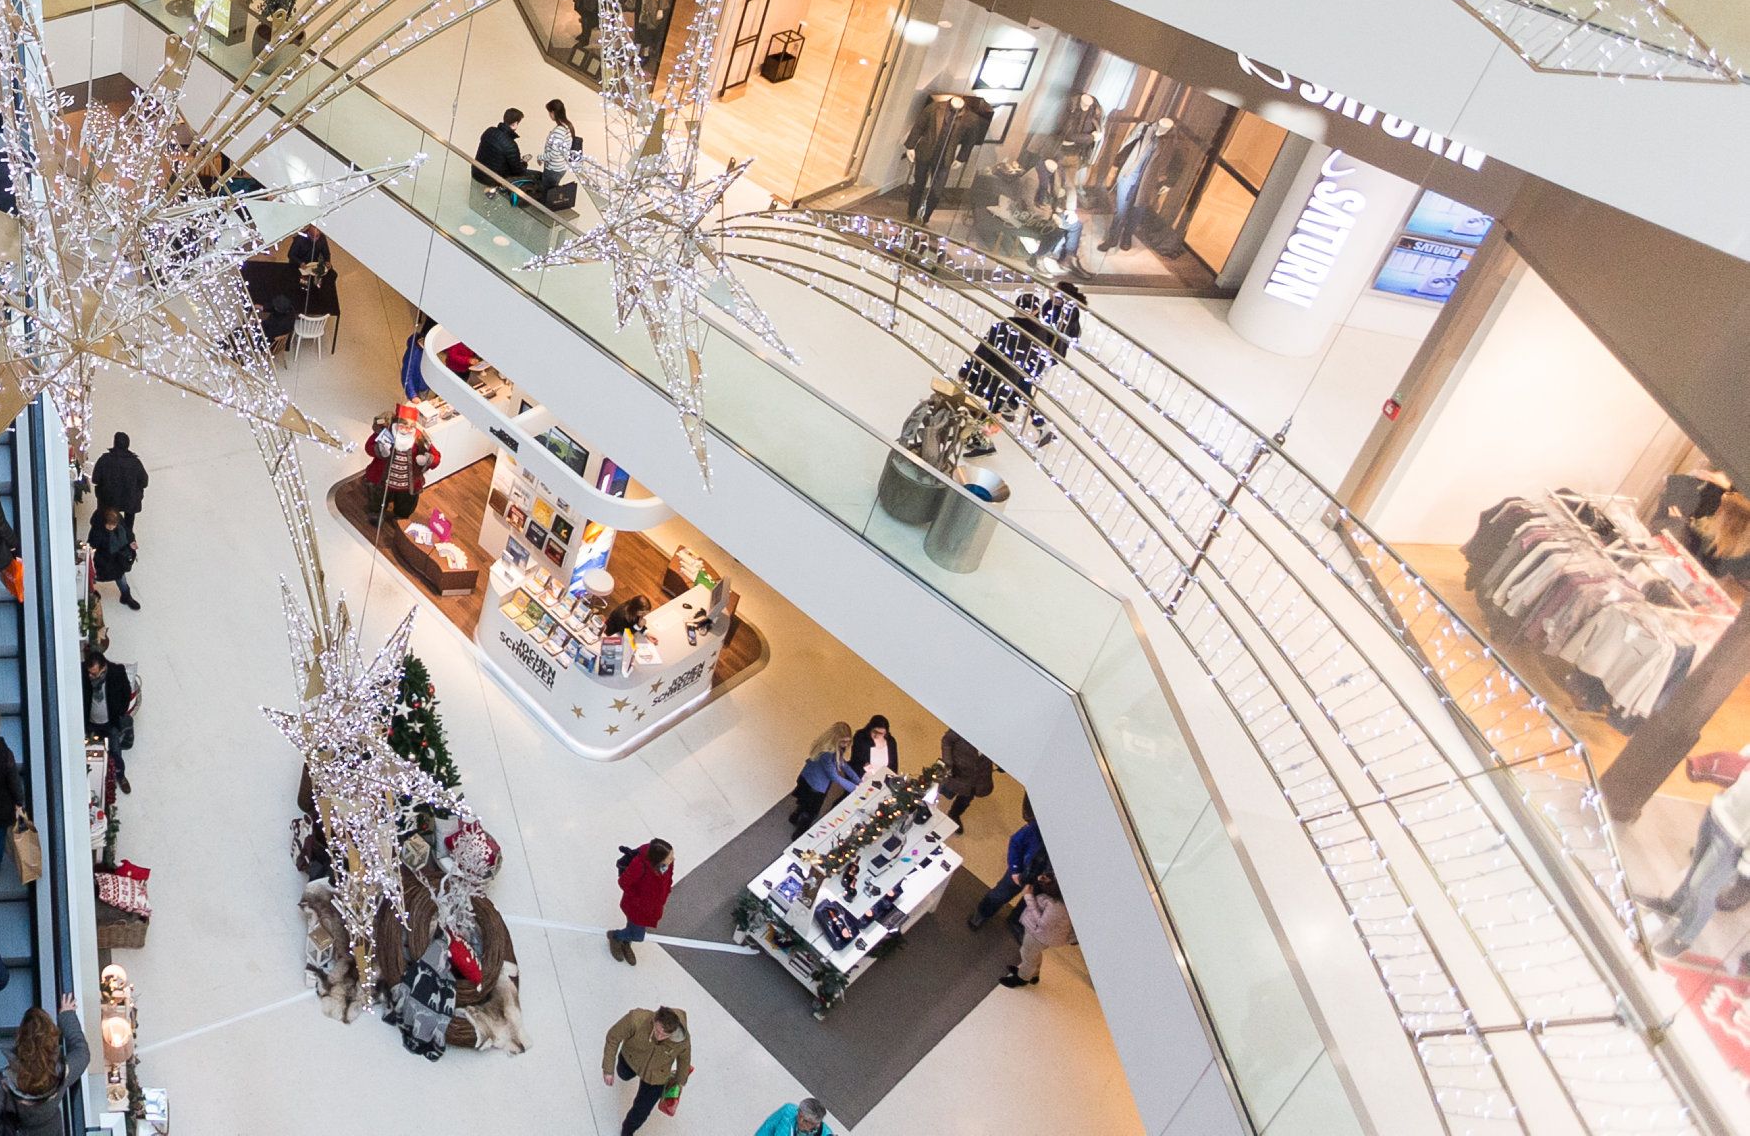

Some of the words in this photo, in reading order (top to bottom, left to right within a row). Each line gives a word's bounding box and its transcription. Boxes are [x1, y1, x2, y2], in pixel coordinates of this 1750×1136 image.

[1263, 180, 1367, 309] SATURN
[1412, 240, 1463, 259] SATURN
[499, 631, 556, 690] SCHWEIZER
[515, 638, 557, 680] JOCHEN
[670, 661, 706, 688] JOCHEN
[652, 671, 703, 707] SCHWEIZER
